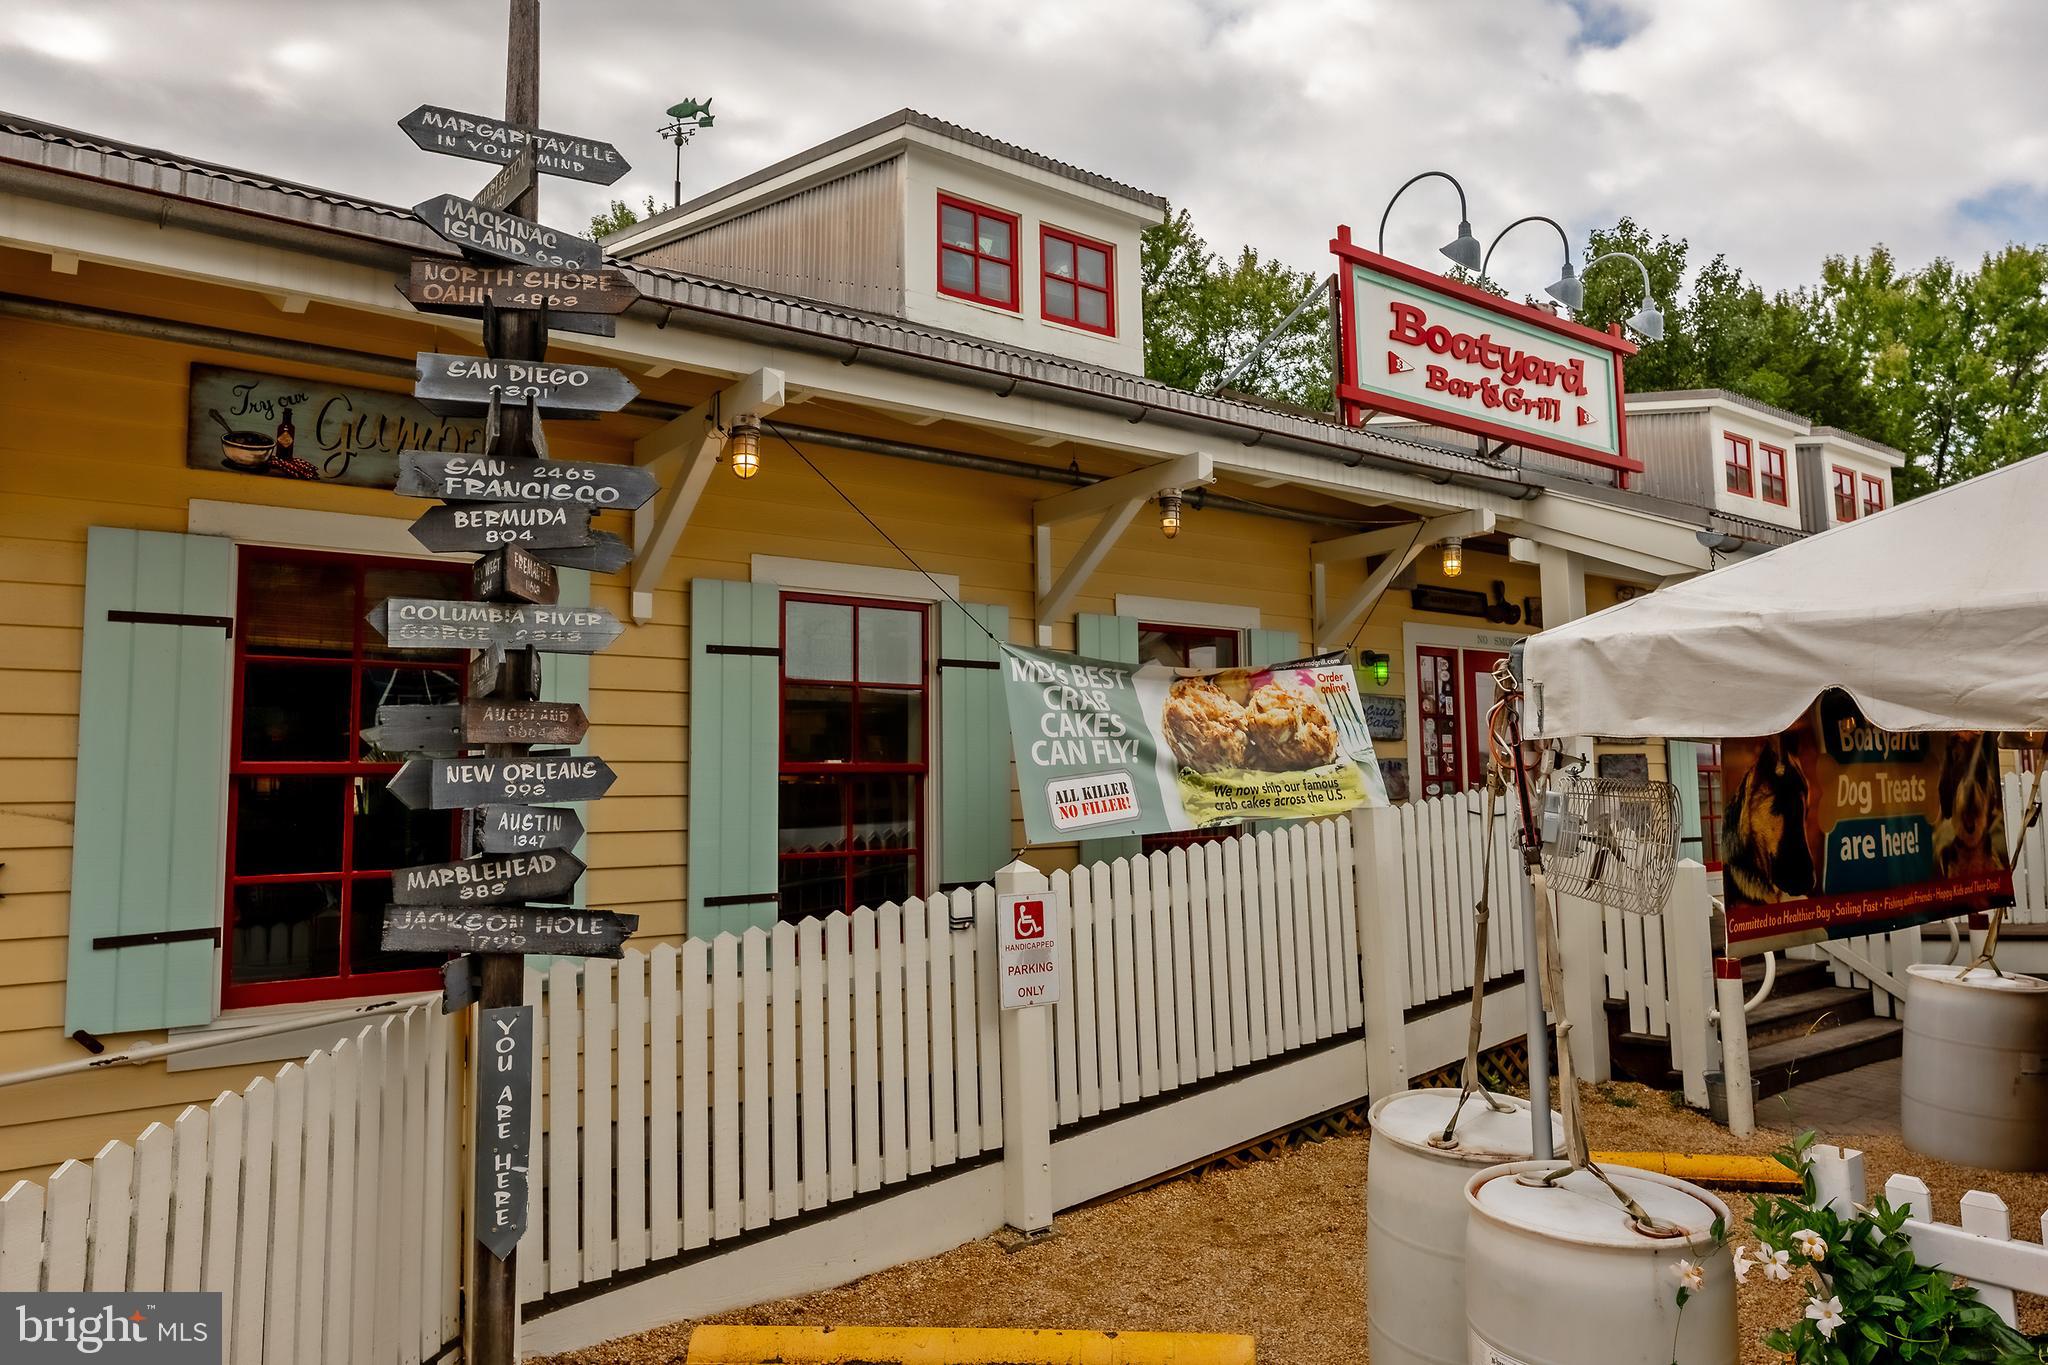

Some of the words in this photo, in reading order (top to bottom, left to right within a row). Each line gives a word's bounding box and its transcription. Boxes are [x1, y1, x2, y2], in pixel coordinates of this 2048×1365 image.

[422, 111, 616, 163] MARGARITAVILLE
[437, 134, 456, 147] IN
[537, 154, 585, 173] MIND
[444, 199, 557, 249] MACKINAC
[444, 218, 526, 256] ISLAND
[535, 250, 580, 270] 630
[424, 263, 513, 287] NORTH
[523, 271, 612, 292] SHORE
[423, 283, 493, 304] OAHU
[513, 293, 578, 307] 4863
[1389, 301, 1588, 397] Boatyard
[447, 361, 498, 379] SAN
[508, 365, 589, 387] DIEGO
[230, 381, 274, 421] Try
[278, 392, 309, 407] our
[444, 457, 505, 477] SAN
[533, 467, 596, 481] 2465
[444, 477, 620, 503] FRANCISCO
[454, 508, 567, 529] BERMUDA
[486, 529, 534, 543] 804
[400, 605, 525, 624] COLUMBIA
[534, 610, 602, 627] RIVER
[400, 623, 490, 641] GORGE
[1070, 664, 1129, 690] BEST
[1317, 672, 1343, 683] Order
[1321, 682, 1351, 694] online!
[1043, 685, 1110, 712] CRAB
[1041, 713, 1127, 738] CAKES
[1031, 740, 1087, 767] CAN
[1094, 739, 1139, 765] FLY!
[446, 764, 495, 784] NEW
[503, 761, 597, 782] ORLEANS
[504, 784, 546, 798] 993
[1055, 787, 1080, 805] ALL
[1083, 781, 1130, 800] KILLER
[1214, 785, 1232, 797] We
[1236, 786, 1259, 796] now
[1263, 781, 1281, 796] ship
[1284, 783, 1300, 793] our
[1303, 778, 1339, 791] famous
[1837, 774, 1873, 814] Dog
[1876, 772, 1926, 805] Treats
[1058, 803, 1079, 819] NO
[1081, 797, 1131, 816] FILLER!
[1214, 797, 1238, 811] crab
[1241, 796, 1271, 809] cakes
[1274, 795, 1306, 807] across
[1307, 792, 1323, 803] the
[1326, 789, 1346, 801] U.S.
[497, 812, 562, 832] AUSTIN
[513, 834, 547, 848] 1347
[1840, 834, 1875, 862] are
[1881, 823, 1920, 857] here!
[407, 854, 557, 891] MARBLEHEAD
[460, 883, 506, 900] 383
[393, 911, 524, 932] JACKSON
[536, 916, 603, 935] HOLE
[1728, 913, 1768, 933] Committed
[1769, 915, 1776, 927] to
[1783, 908, 1816, 925] Healthier
[1816, 904, 1831, 922] Bay
[1835, 901, 1862, 918] Sailing
[1863, 899, 1878, 913] Fast
[470, 934, 527, 949] 1799
[1005, 940, 1054, 952] HANDICAPPED
[1008, 961, 1054, 976] PARKING
[1018, 985, 1045, 998] ONLY
[495, 1017, 517, 1072] YOU
[495, 1085, 513, 1139] ARE
[494, 1153, 512, 1226] HERE
